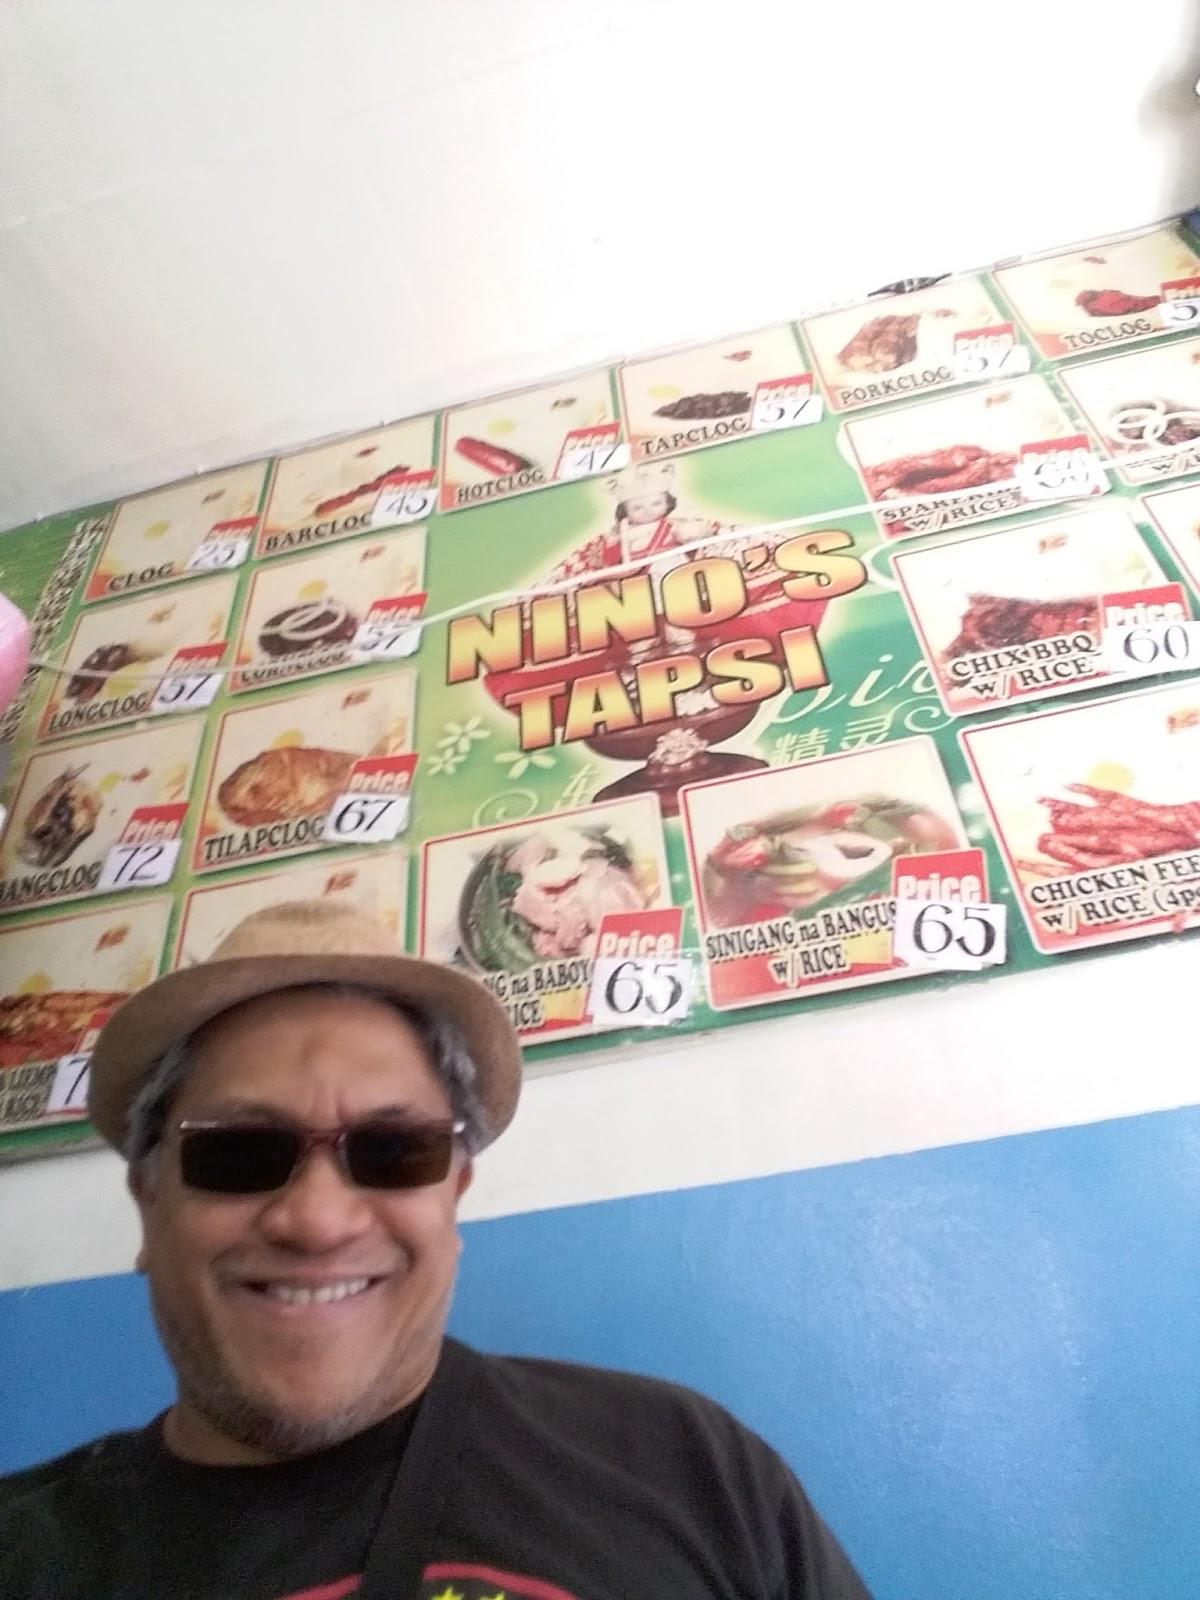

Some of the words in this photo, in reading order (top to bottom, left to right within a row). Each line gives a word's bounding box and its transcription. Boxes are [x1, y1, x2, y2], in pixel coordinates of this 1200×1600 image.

[1064, 318, 1151, 348] TOCLOG
[839, 365, 953, 405] PORKCLOG
[641, 416, 748, 456] TAPCLOG
[457, 467, 545, 503] HOTCLOG
[952, 498, 1011, 520] RICE
[108, 561, 176, 592] CLOG
[446, 528, 868, 686] NINO'S
[1123, 625, 1190, 664] 60
[951, 649, 1026, 678] CHIX
[1017, 656, 1093, 687] RICE
[504, 624, 832, 752] TAPSI
[49, 691, 150, 731] LONGCLOG
[350, 770, 411, 793] Price
[334, 798, 397, 834] 67
[205, 814, 326, 861] TILAPCLOG
[114, 845, 165, 884] 72
[898, 873, 981, 901] Price
[1030, 865, 1150, 904] CHICKEN
[1080, 892, 1148, 921] RICE
[601, 930, 676, 959] Price
[704, 920, 796, 961] SINIGANG
[800, 925, 820, 944] na
[912, 903, 997, 957] 65
[533, 959, 590, 991] BABOY
[803, 944, 847, 976] RICE
[604, 960, 684, 1015] 65
[505, 1000, 541, 1027] ICE
